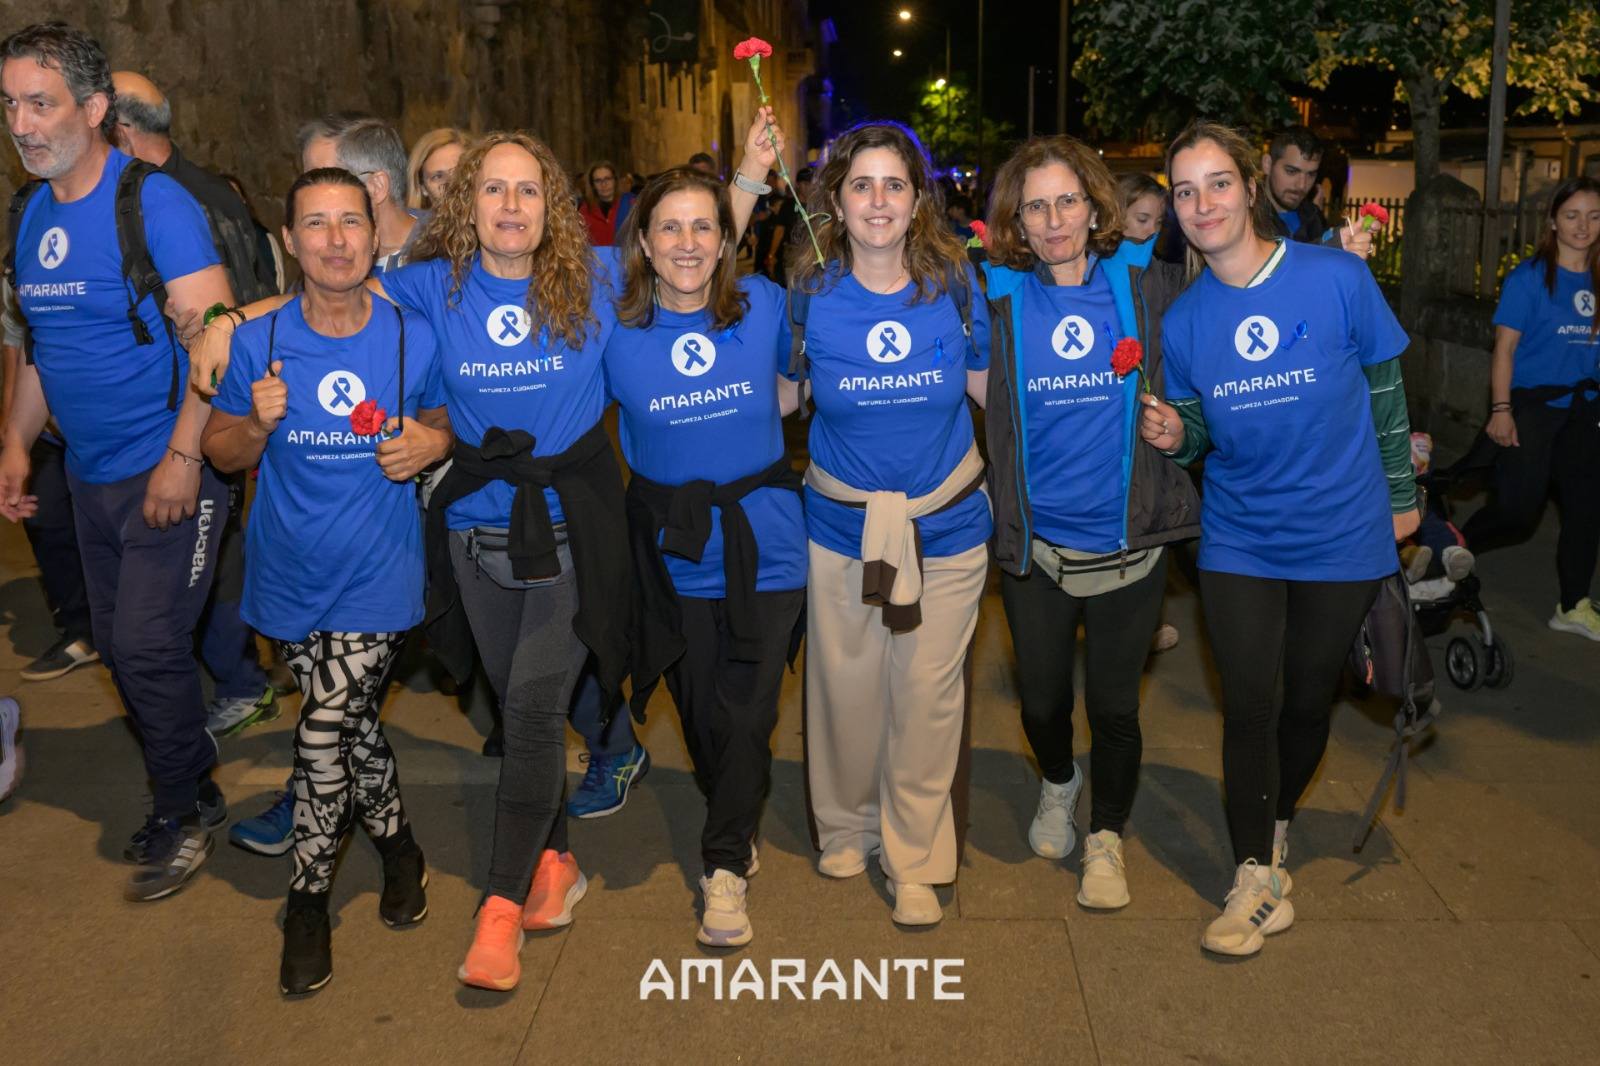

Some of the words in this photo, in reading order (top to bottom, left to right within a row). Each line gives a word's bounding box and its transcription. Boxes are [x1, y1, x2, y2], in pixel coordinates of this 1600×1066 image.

[18, 281, 87, 297] AMARANTE
[459, 355, 564, 377] AMARANTE
[838, 369, 944, 391] AMARANTE
[1213, 367, 1317, 399] AMARANTE
[649, 381, 754, 413] AMARANTE
[188, 499, 214, 588] macron
